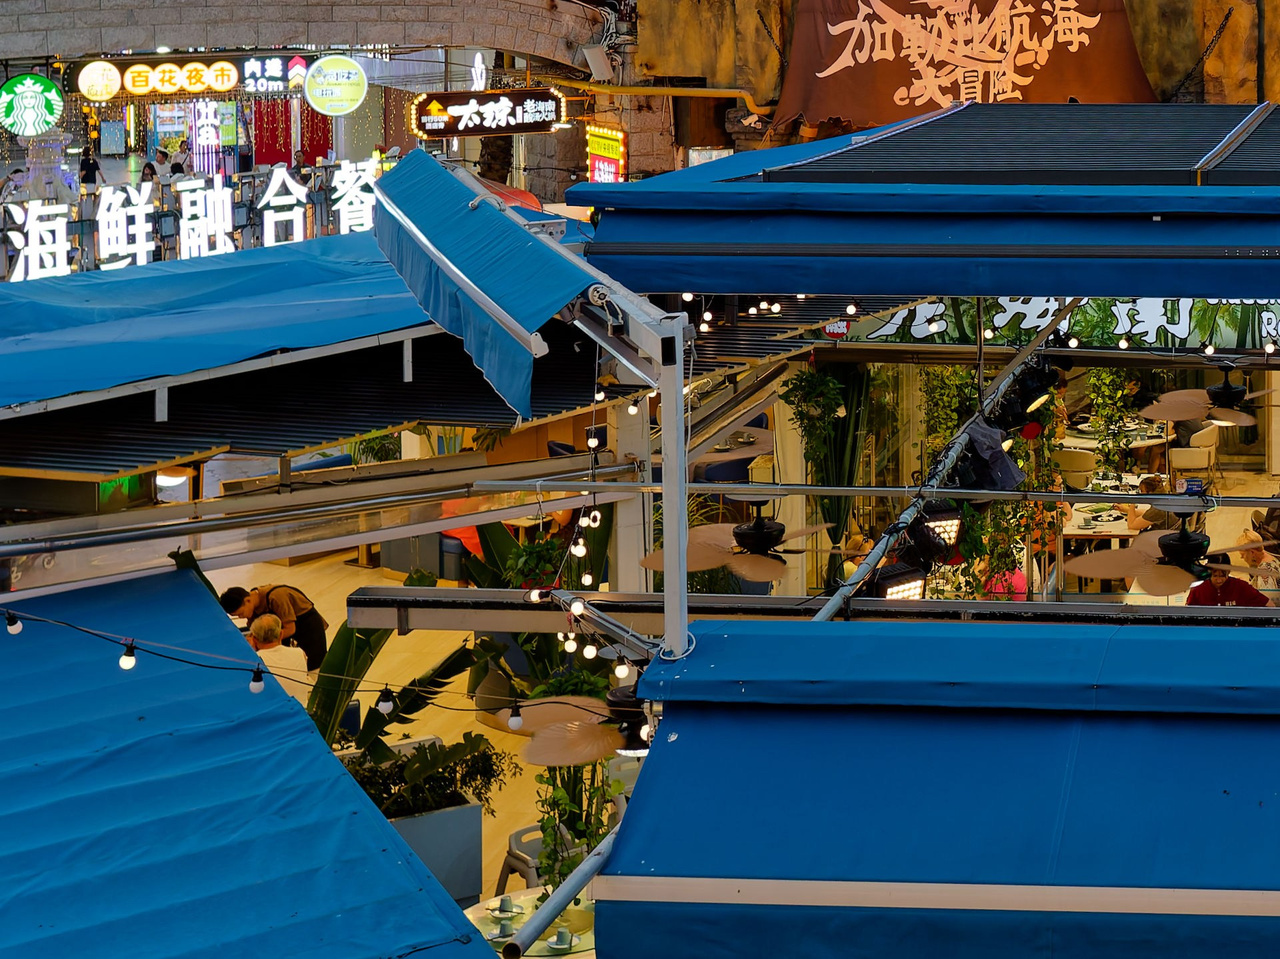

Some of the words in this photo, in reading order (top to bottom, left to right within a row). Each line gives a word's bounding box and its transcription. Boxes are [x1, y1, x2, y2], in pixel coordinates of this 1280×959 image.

[129, 66, 234, 89] 百花夜市
[244, 78, 284, 92] 20m
[6, 159, 377, 283] 海鲜融合餐
